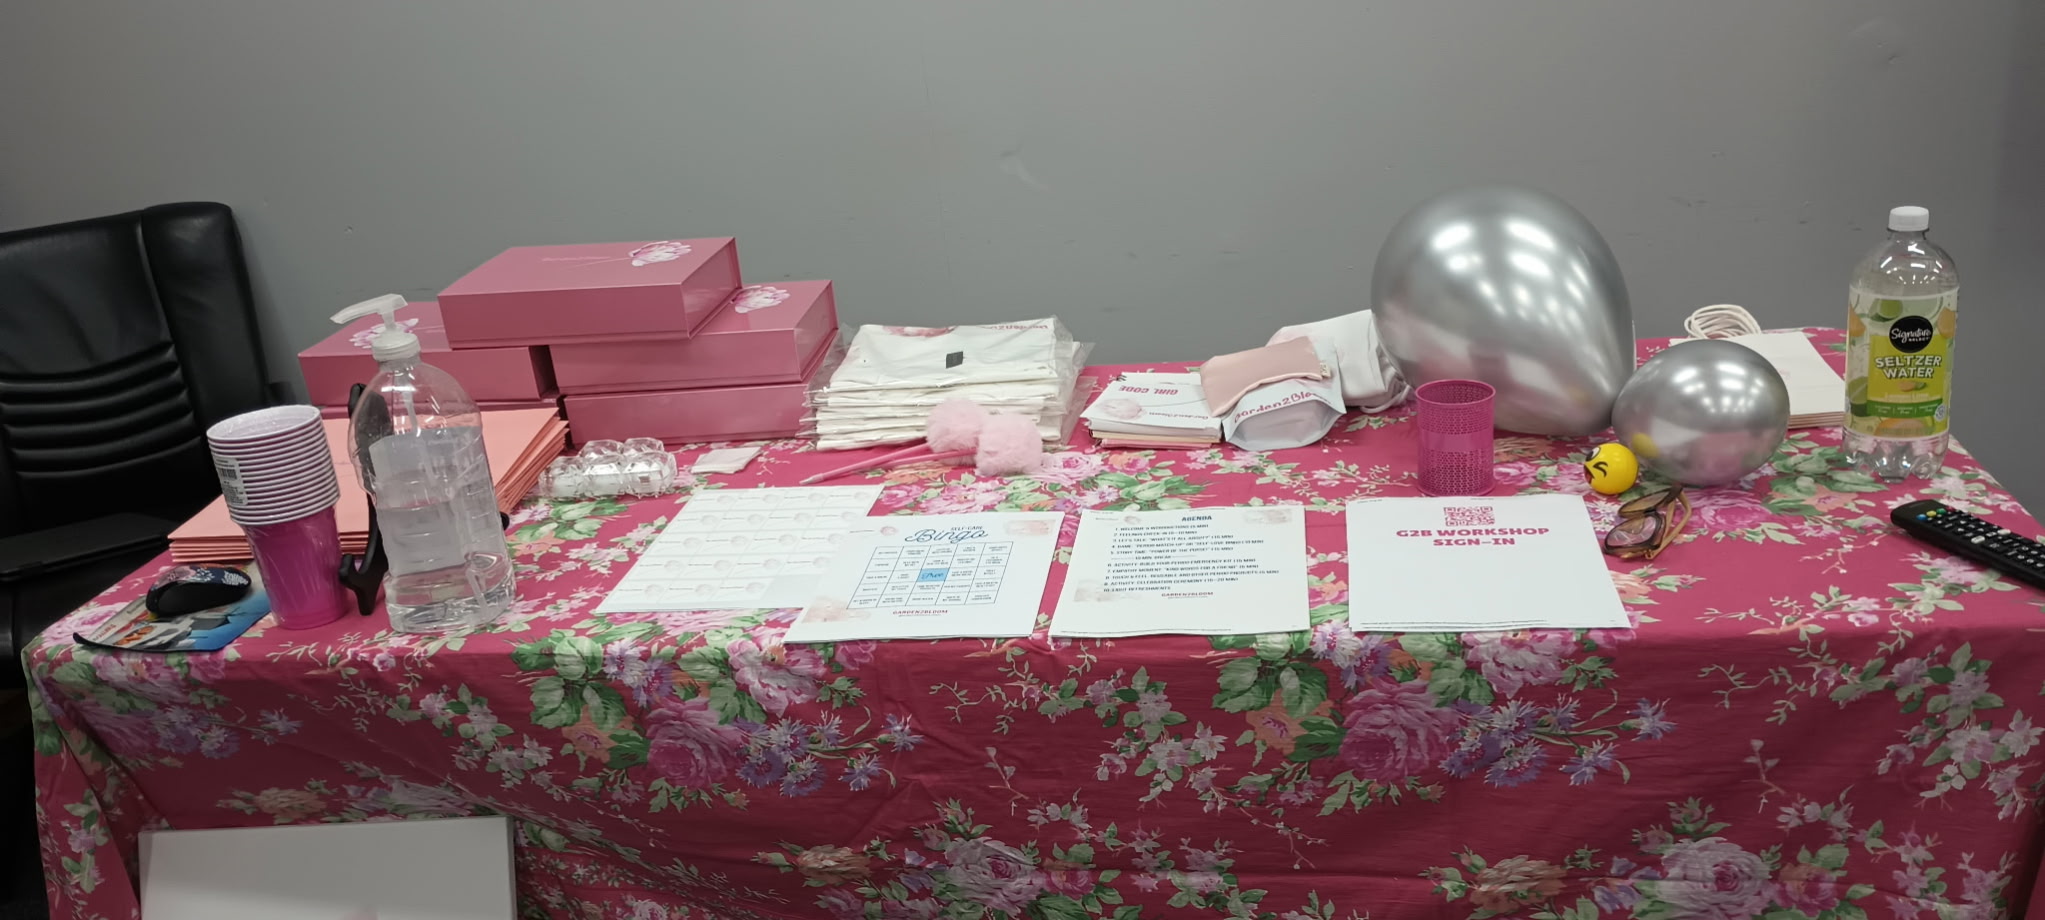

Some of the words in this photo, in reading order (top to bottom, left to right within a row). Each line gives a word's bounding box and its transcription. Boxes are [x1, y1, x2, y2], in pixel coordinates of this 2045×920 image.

[1891, 328, 1932, 344] Signature
[1875, 355, 1942, 368] SELTZER
[1883, 367, 1934, 379] WATER
[1118, 385, 1150, 395] CODE
[1152, 386, 1180, 396] GIRL
[904, 528, 989, 544] Bingo
[1437, 528, 1550, 536] WORKSHOP
[1433, 538, 1516, 546] SIGN-IN
